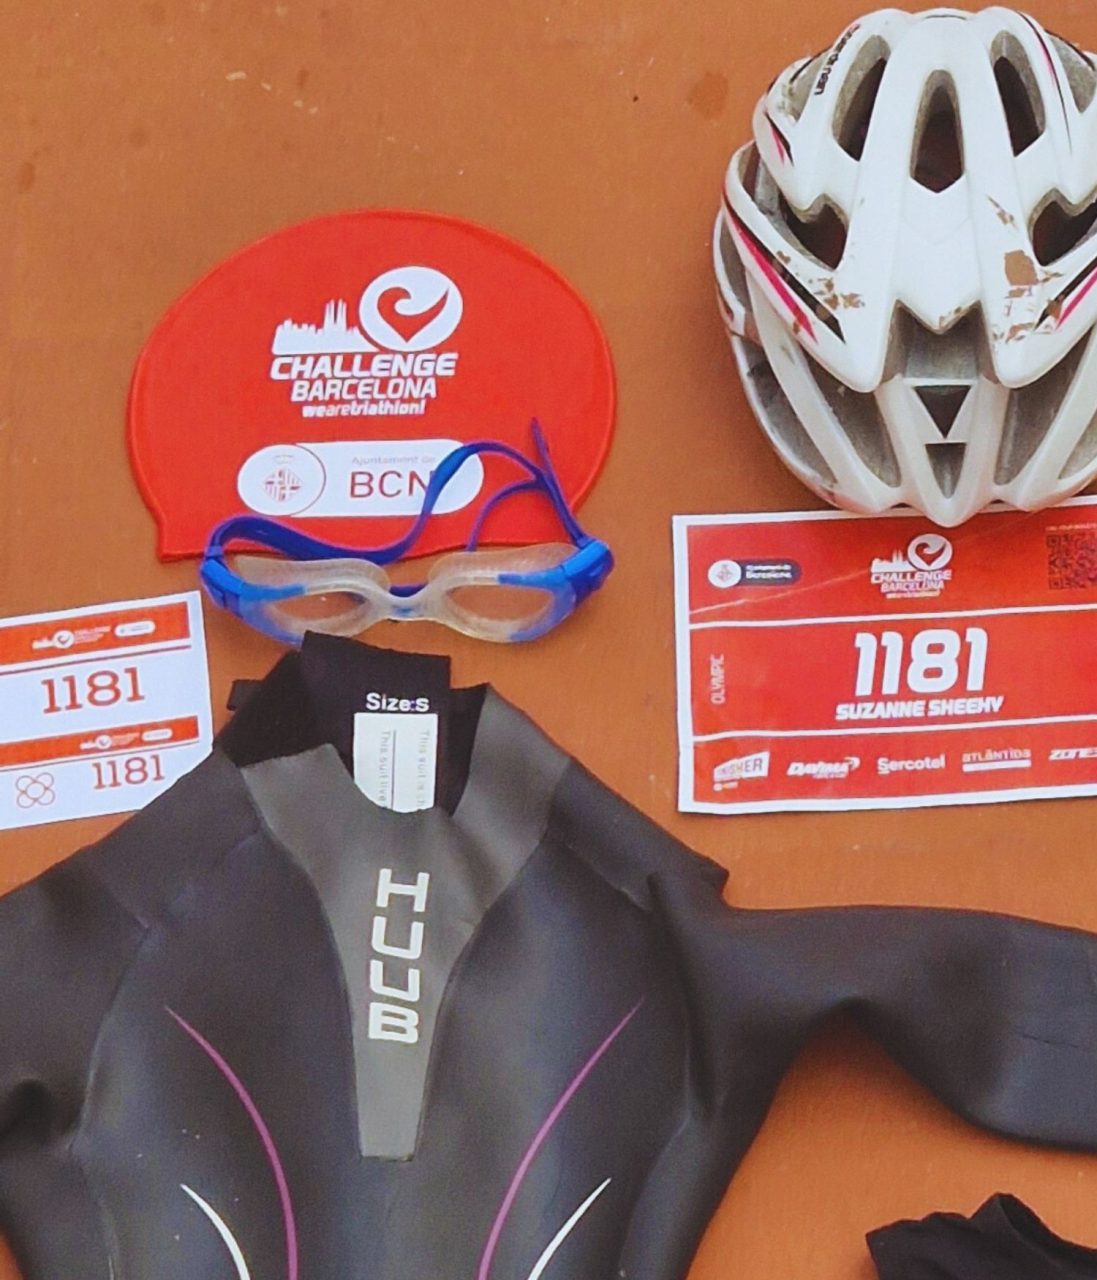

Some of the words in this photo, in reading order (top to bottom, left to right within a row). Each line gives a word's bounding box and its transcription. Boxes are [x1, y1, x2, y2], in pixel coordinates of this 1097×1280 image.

[270, 352, 459, 380] CHALLENGE
[290, 378, 437, 402] BARCELONA
[350, 469, 436, 498] BCN
[871, 569, 953, 584] CHALLENGE
[854, 627, 989, 697] 1181
[41, 666, 145, 715] 1181
[835, 700, 927, 721] SUZANNE
[92, 754, 165, 790] 1181
[878, 754, 946, 773] Sercotel
[368, 868, 430, 1044] HUUB
